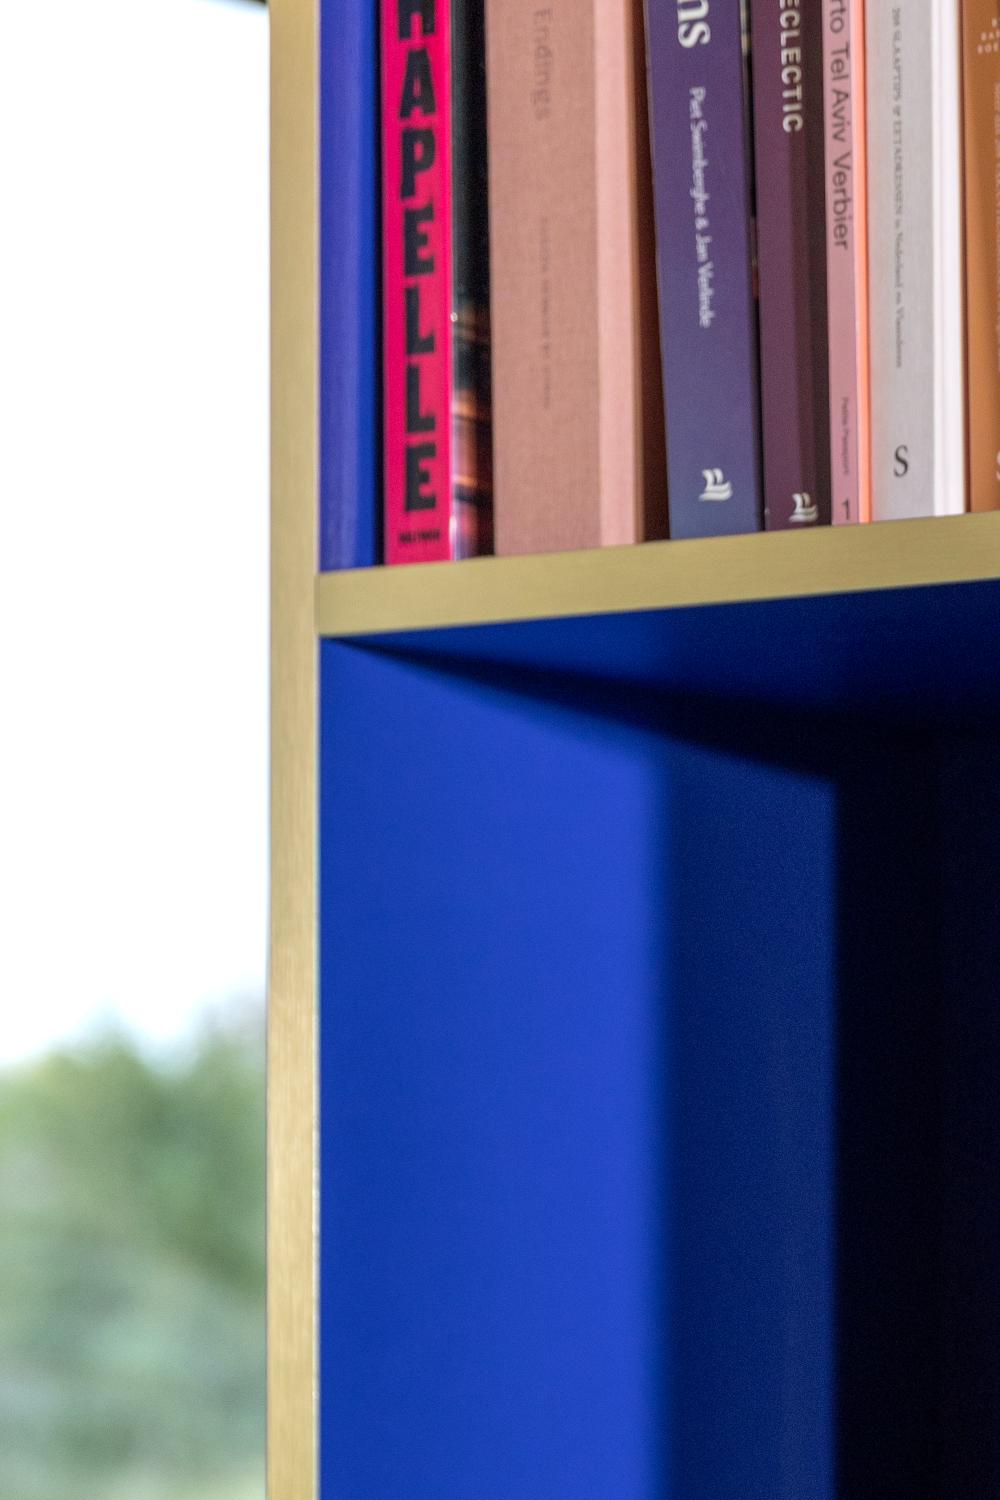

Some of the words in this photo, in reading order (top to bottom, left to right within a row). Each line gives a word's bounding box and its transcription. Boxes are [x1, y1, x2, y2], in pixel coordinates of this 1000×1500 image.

[830, 42, 850, 81] Tel
[831, 89, 851, 142] Aviv
[832, 152, 853, 250] Verbier
[696, 233, 713, 262] Jan
[893, 445, 909, 478] S
